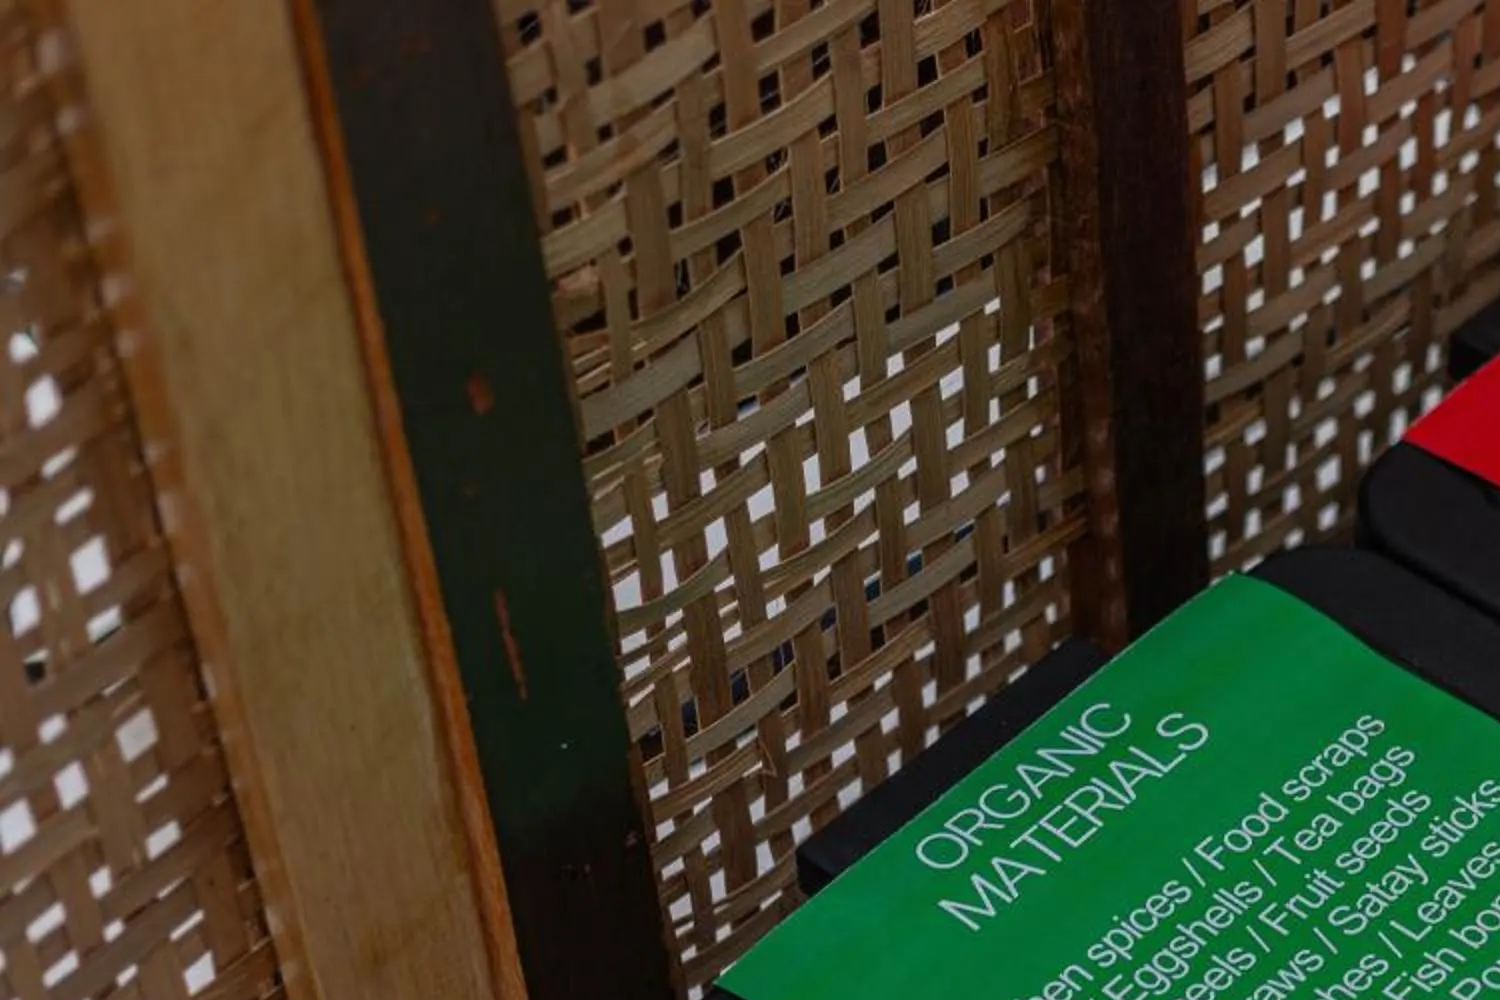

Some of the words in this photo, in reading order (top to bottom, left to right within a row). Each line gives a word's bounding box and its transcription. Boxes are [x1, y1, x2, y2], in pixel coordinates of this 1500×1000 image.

[915, 703, 1132, 869] ORGANIC
[1281, 714, 1385, 802] scraps
[1325, 745, 1415, 816] bags
[937, 712, 1209, 931] MATERIALS
[1193, 791, 1290, 871] Food
[1262, 813, 1343, 865] Tea
[1335, 789, 1431, 875] seeds
[1181, 857, 1207, 888] /
[1252, 858, 1278, 887] /
[1257, 868, 1345, 936] Fruit
[1312, 927, 1339, 955] /
[1327, 853, 1429, 935] Satay
[1087, 879, 1192, 968] spices
[1245, 925, 1271, 953] /
[1377, 931, 1403, 959] /
